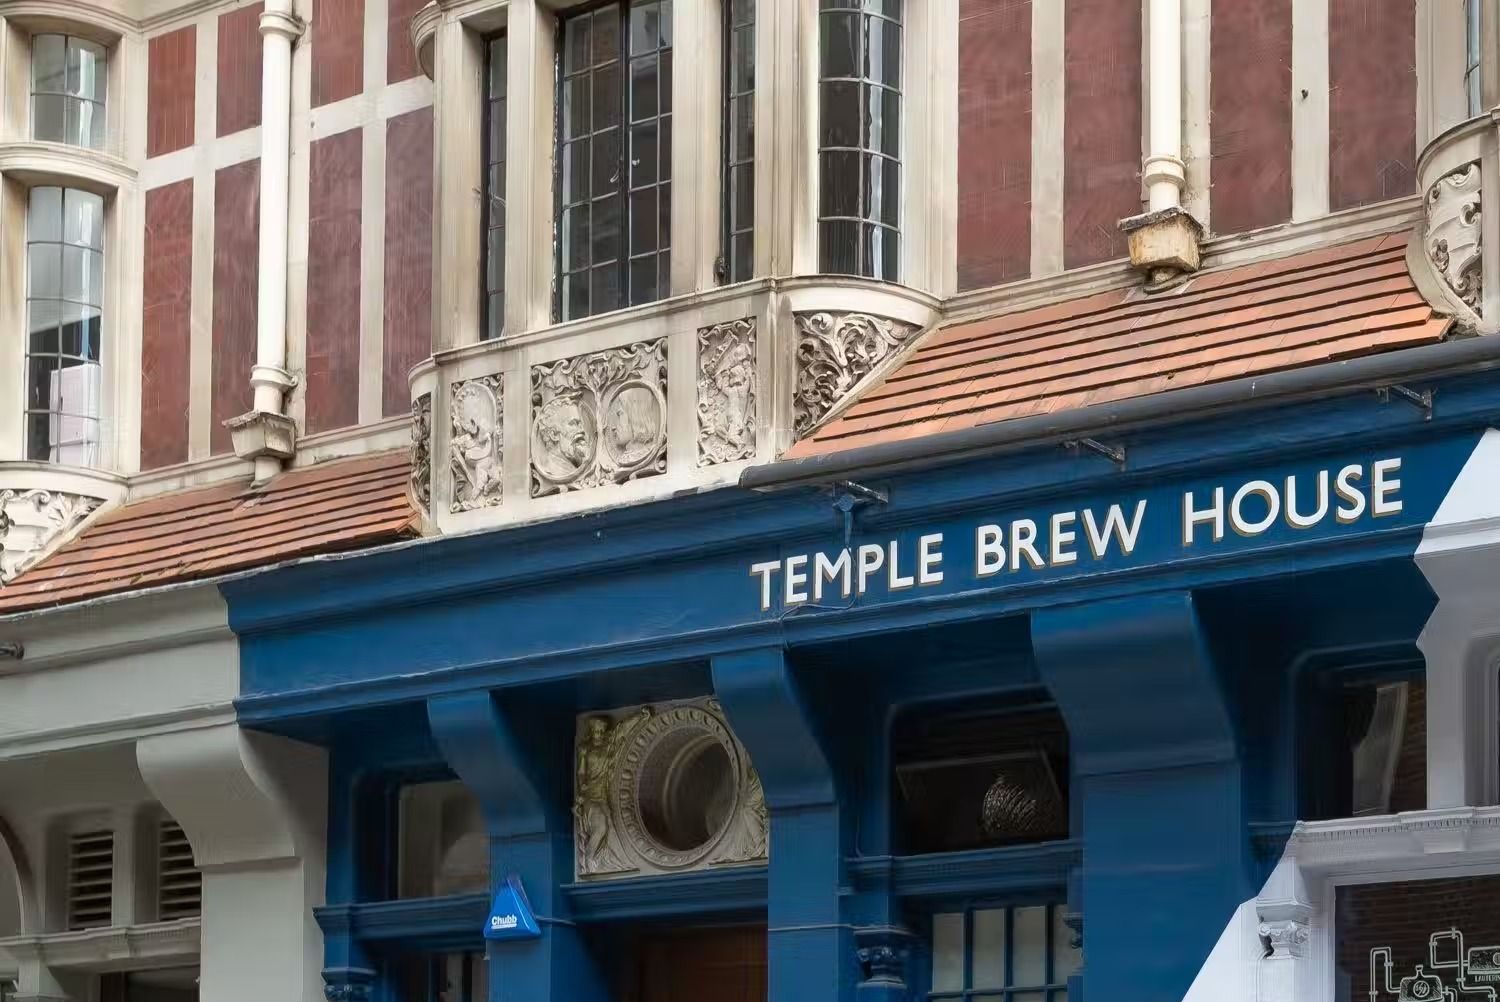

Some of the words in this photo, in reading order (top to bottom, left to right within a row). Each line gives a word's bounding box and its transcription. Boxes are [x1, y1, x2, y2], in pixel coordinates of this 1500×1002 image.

[751, 532, 944, 610] TEMPLE
[975, 499, 1147, 578] BREW
[1183, 458, 1403, 545] HOUSE
[491, 914, 518, 926] Chubb
